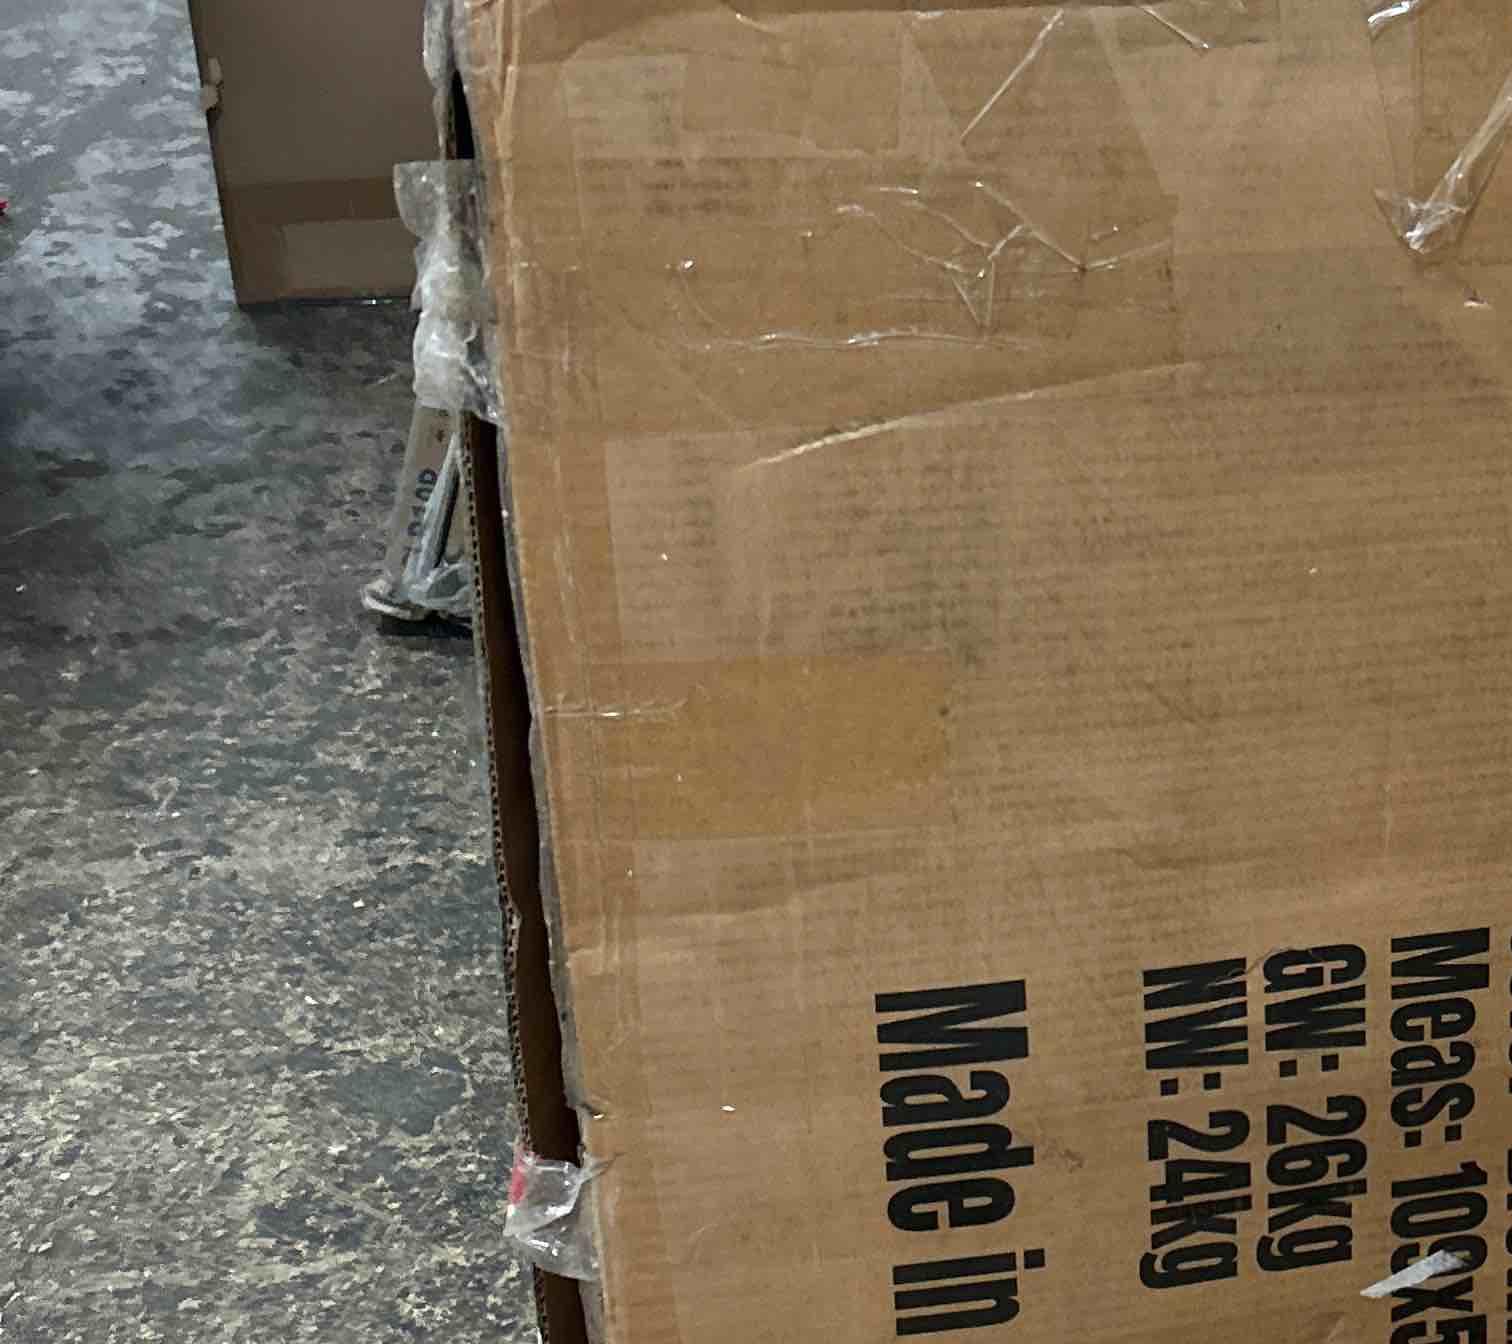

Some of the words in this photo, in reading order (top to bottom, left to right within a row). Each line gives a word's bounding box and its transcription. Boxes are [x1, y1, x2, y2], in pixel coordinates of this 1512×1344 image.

[1143, 958, 1248, 1096] NW:
[1263, 944, 1366, 1077] GW:
[1390, 927, 1490, 1146] Meas:
[874, 978, 1034, 1232] Made
[1256, 1095, 1367, 1271] 26kg
[1139, 1108, 1252, 1289] 24kg
[893, 1248, 1047, 1336] in
